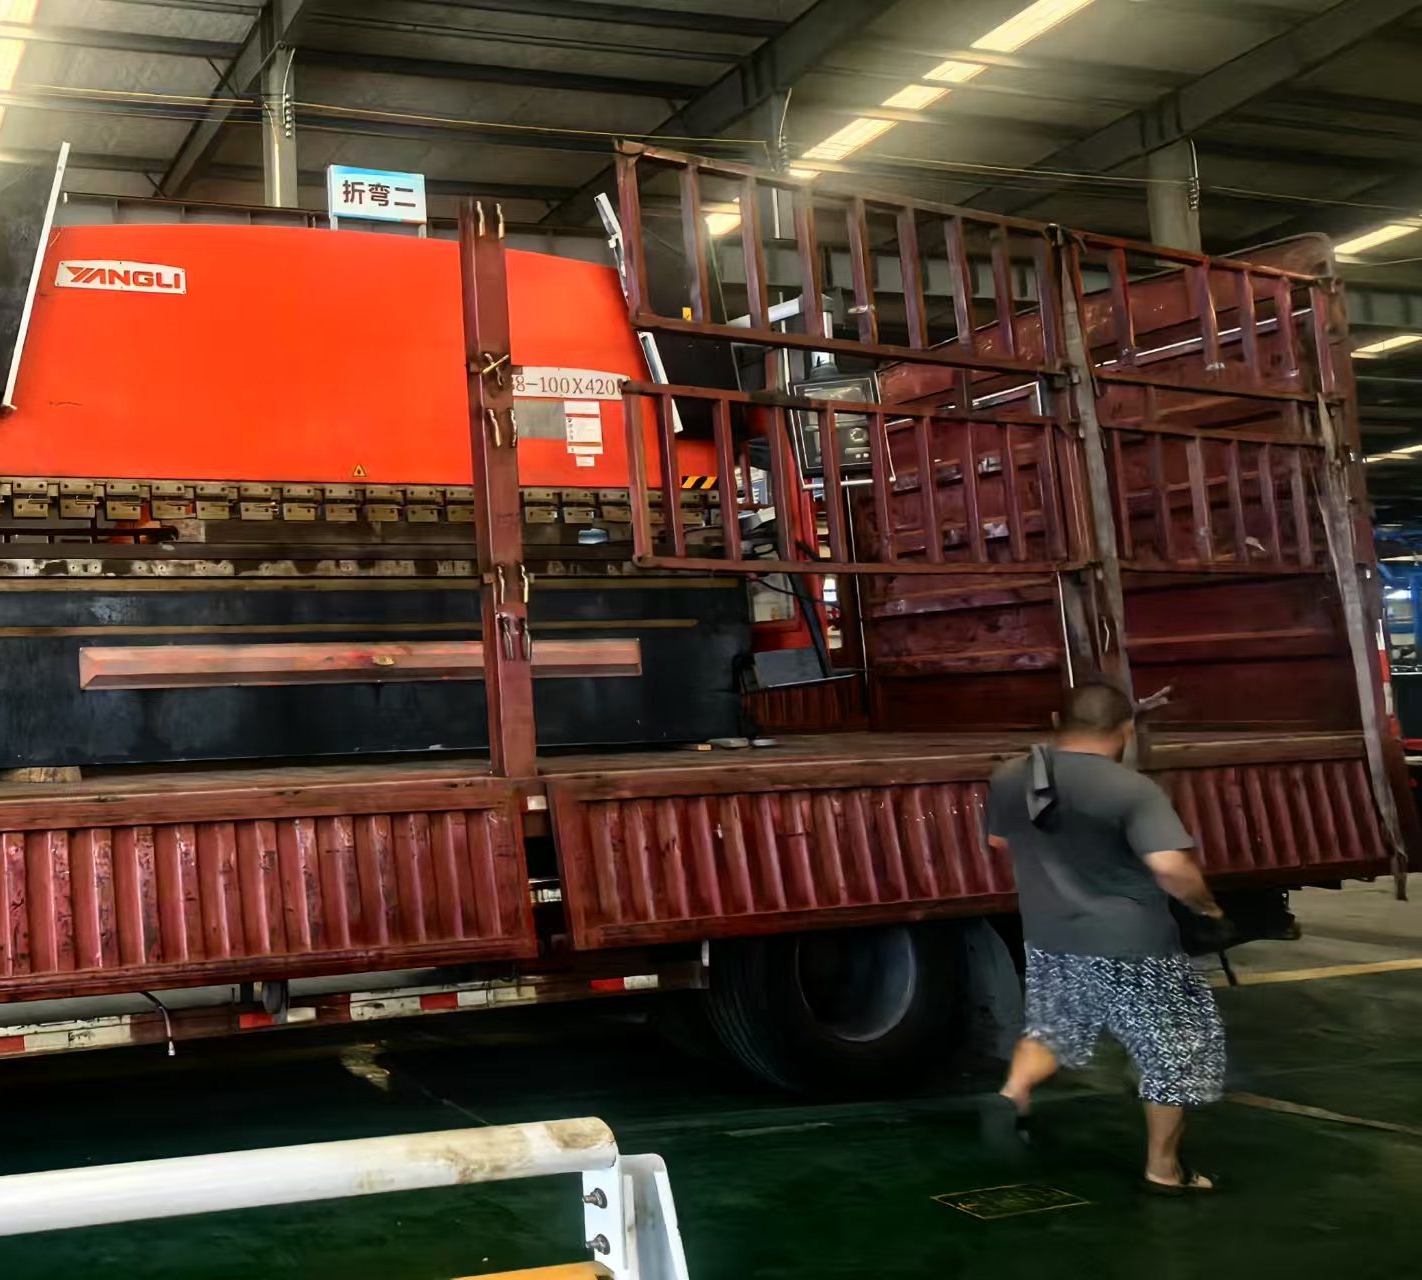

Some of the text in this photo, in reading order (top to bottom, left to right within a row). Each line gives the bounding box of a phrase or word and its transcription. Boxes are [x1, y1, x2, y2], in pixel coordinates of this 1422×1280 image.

[342, 179, 416, 208] 折弯二
[64, 265, 182, 290] YANGLI
[512, 375, 622, 397] 8-100X420
